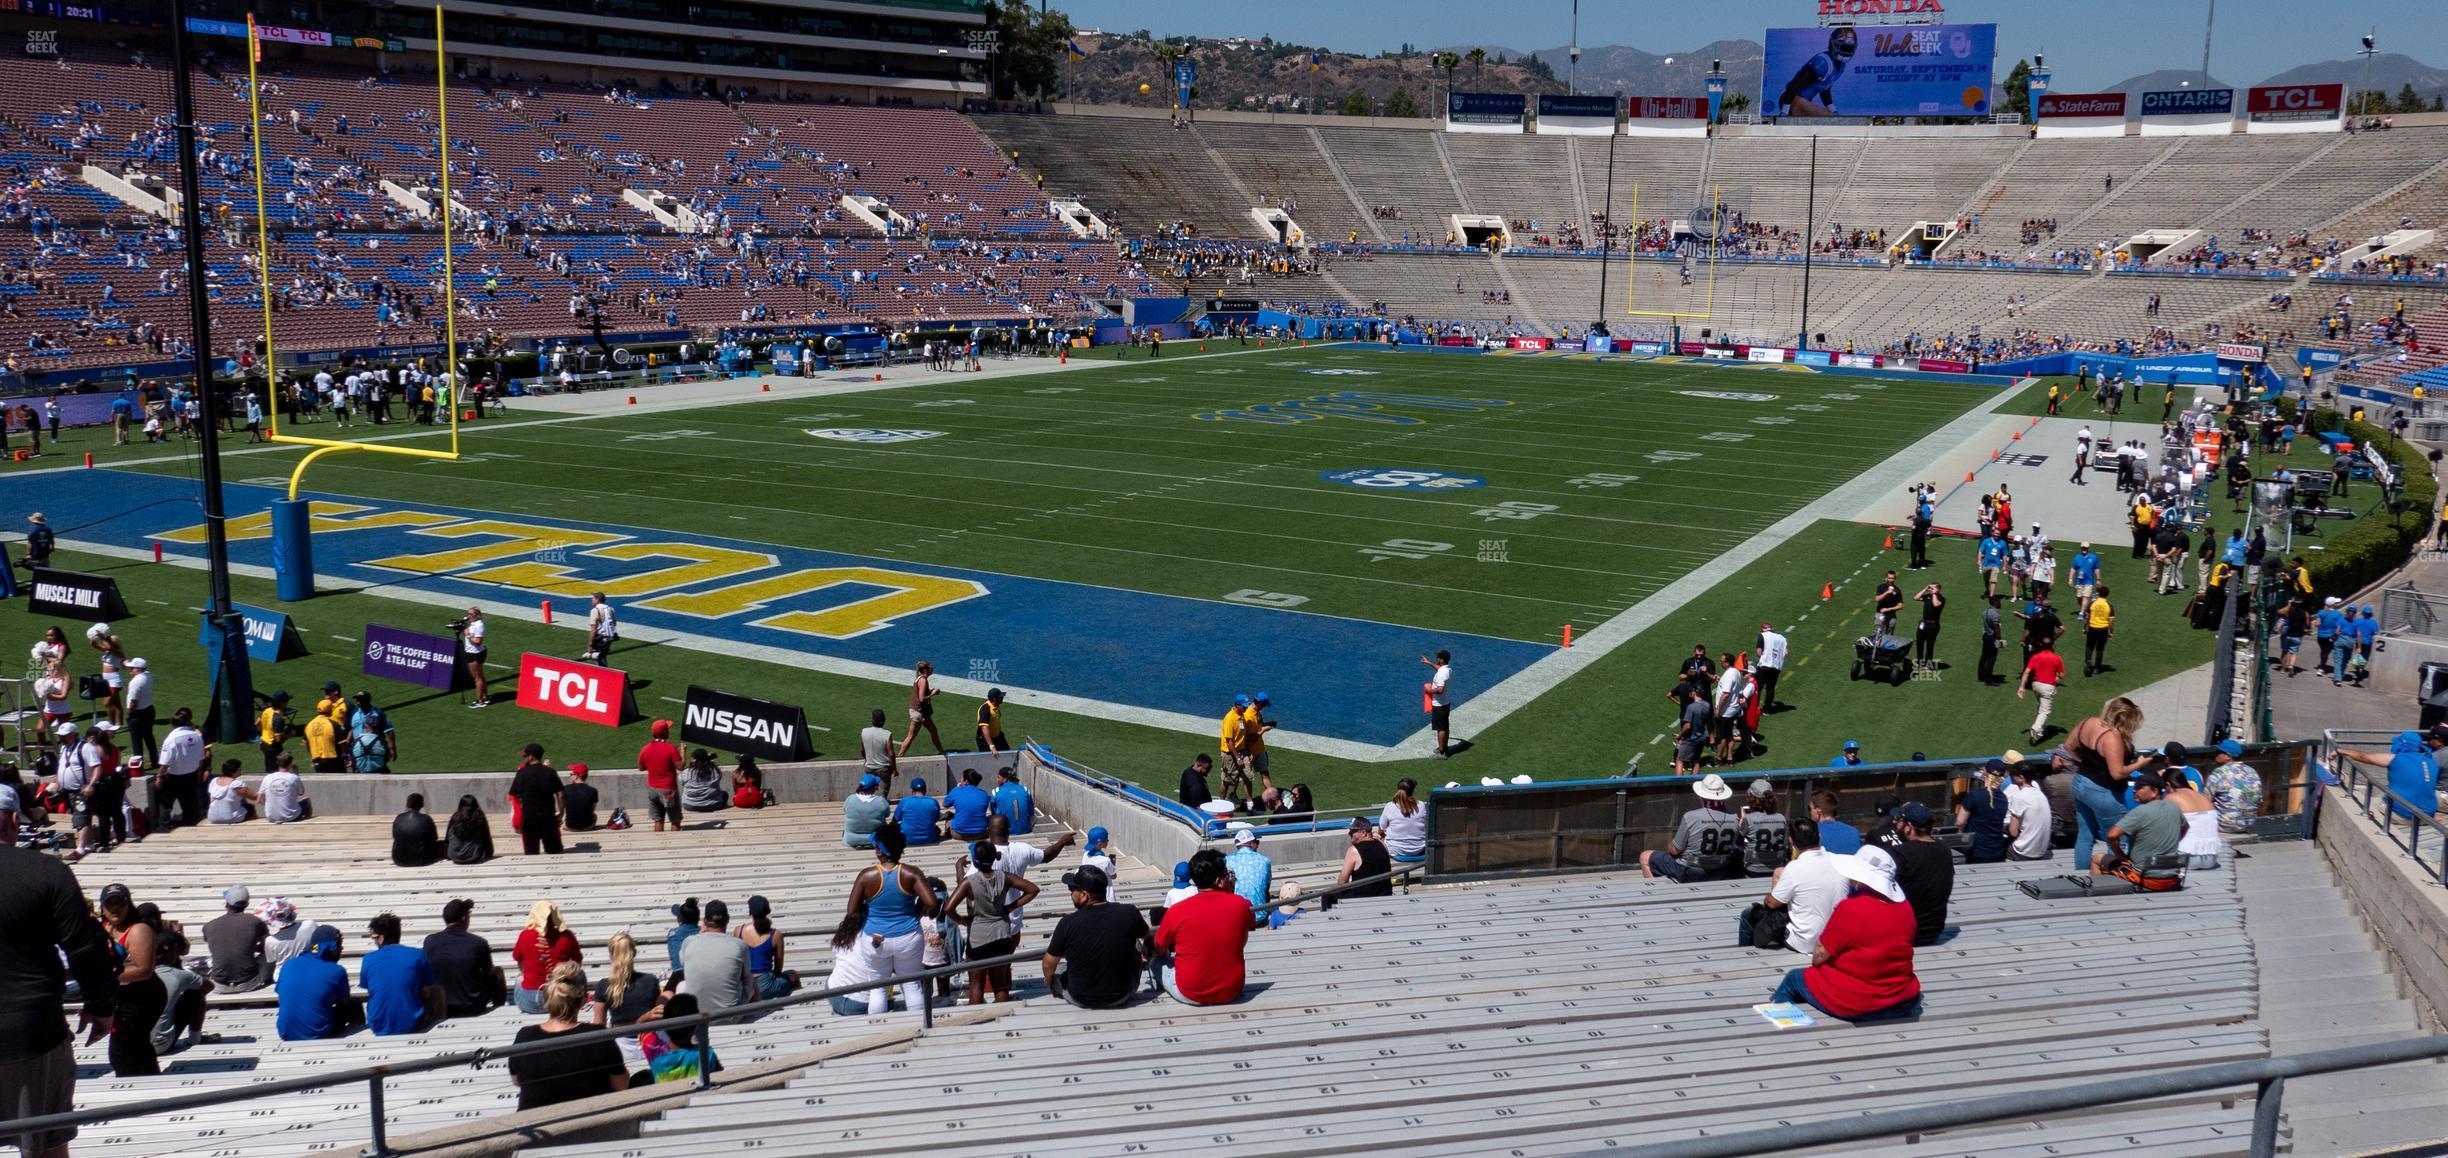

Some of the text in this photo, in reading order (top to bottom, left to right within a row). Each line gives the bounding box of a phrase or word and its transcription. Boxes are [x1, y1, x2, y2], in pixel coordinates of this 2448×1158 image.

[66, 6, 94, 18] 20:21
[1817, 0, 1944, 15] HONDA
[262, 27, 289, 38] TCL
[299, 31, 326, 42] TCL
[1911, 65, 1973, 73] SEPTEMBER
[1877, 74, 1920, 82] KICKOFF
[1922, 74, 1937, 82] AT
[2144, 91, 2231, 107] ONTARIO
[2264, 88, 2324, 109] TCL
[1927, 225, 1944, 238] 40
[1676, 240, 1737, 258] Allstate
[1519, 340, 1542, 348] TCL
[2219, 346, 2260, 358] HONDA
[1469, 501, 1560, 520] 20
[1357, 539, 1455, 559] 10
[144, 500, 991, 640] UCLA
[35, 583, 102, 609] MUSCLE MILK
[2375, 640, 2385, 652] 2
[386, 643, 455, 665] THE COFFEE BEAN
[392, 656, 406, 666] TEA
[407, 658, 427, 669] LEAF
[533, 667, 608, 713] TCL
[685, 703, 794, 747] NISSAN
[1700, 828, 1736, 855] 82
